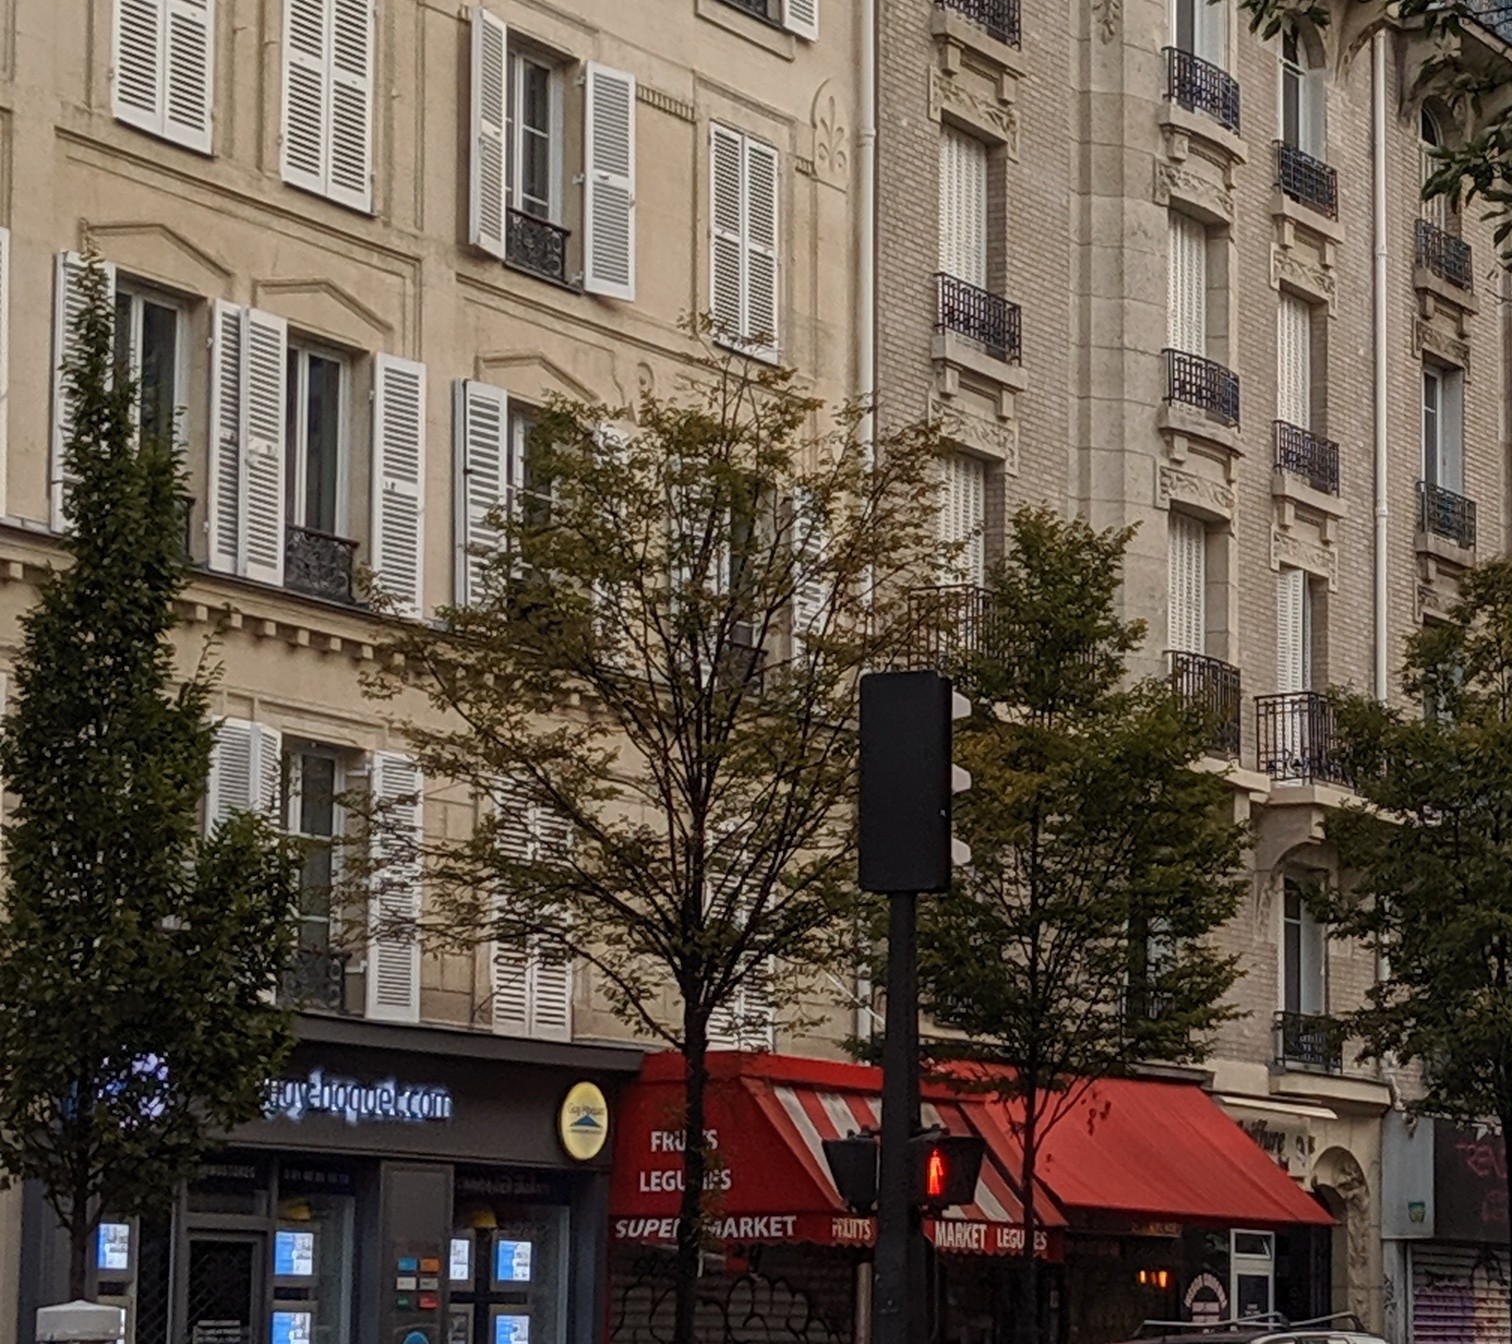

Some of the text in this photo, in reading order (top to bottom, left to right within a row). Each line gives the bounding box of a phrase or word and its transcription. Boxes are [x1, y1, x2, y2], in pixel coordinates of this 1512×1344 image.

[650, 1129, 719, 1153] FRUS
[936, 1220, 987, 1249] MARKET
[996, 1227, 1048, 1251] LEGUES
